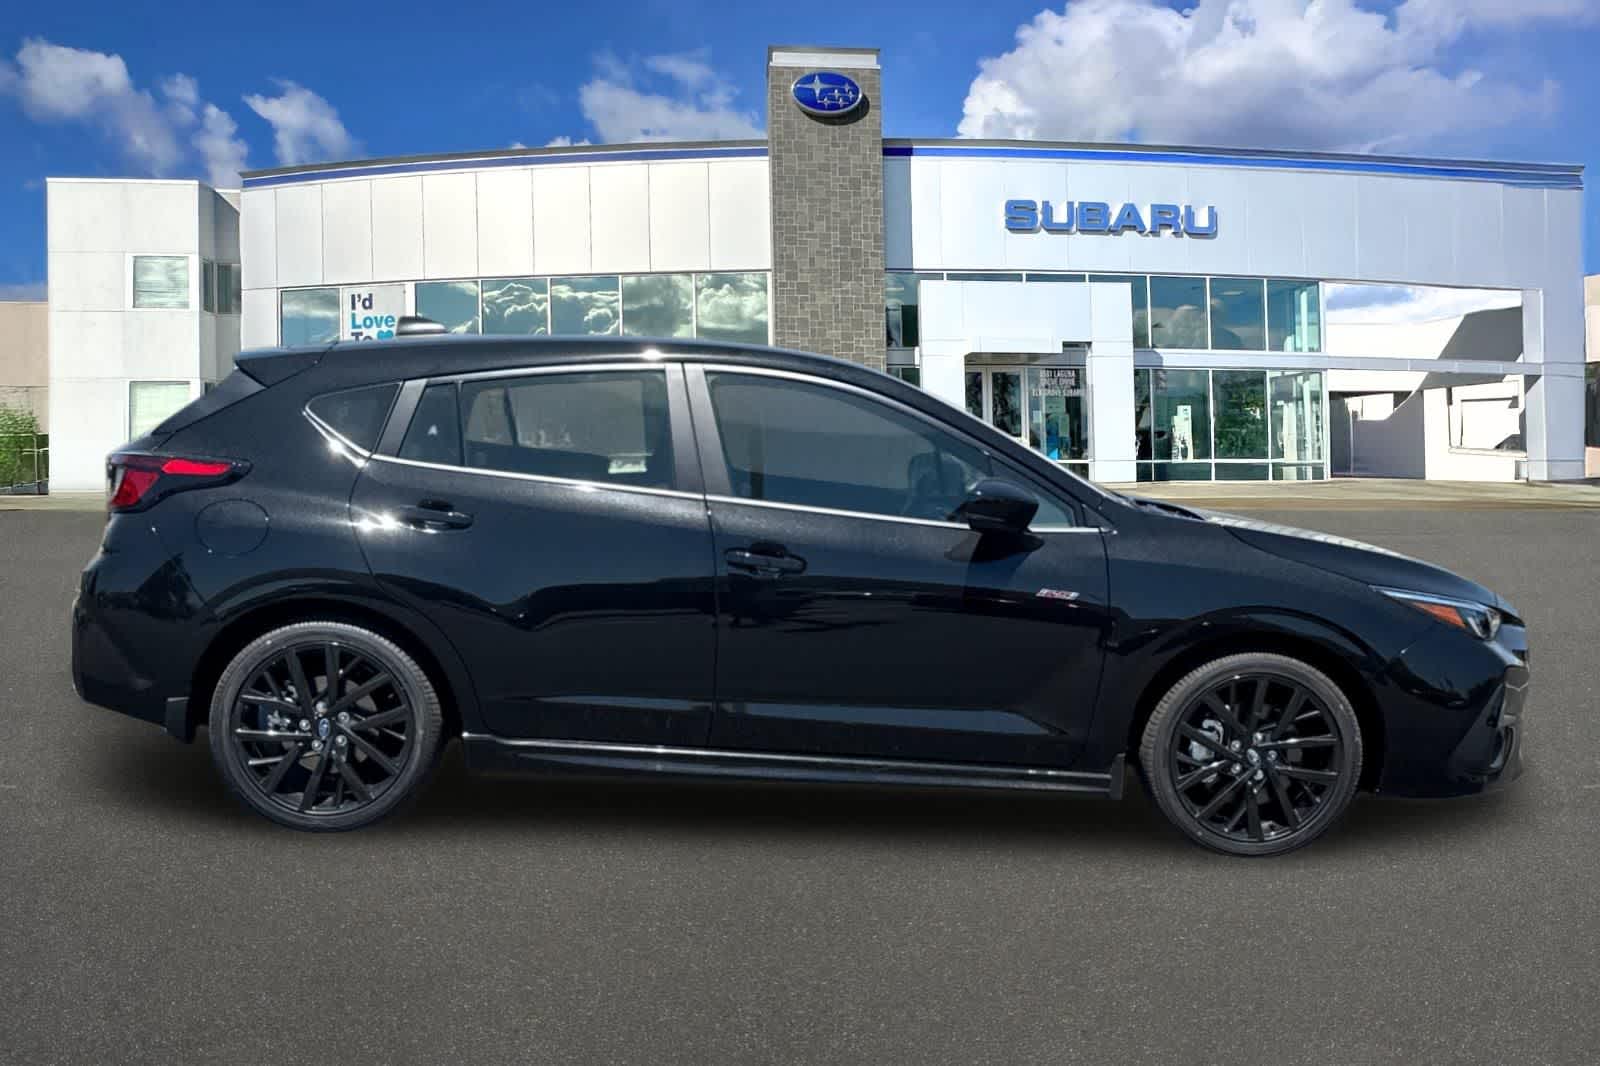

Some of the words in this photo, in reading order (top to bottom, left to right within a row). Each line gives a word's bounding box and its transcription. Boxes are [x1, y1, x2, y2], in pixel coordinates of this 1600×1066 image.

[1005, 199, 1217, 237] SUBARU
[351, 293, 373, 310] I'd
[351, 312, 396, 329] Love
